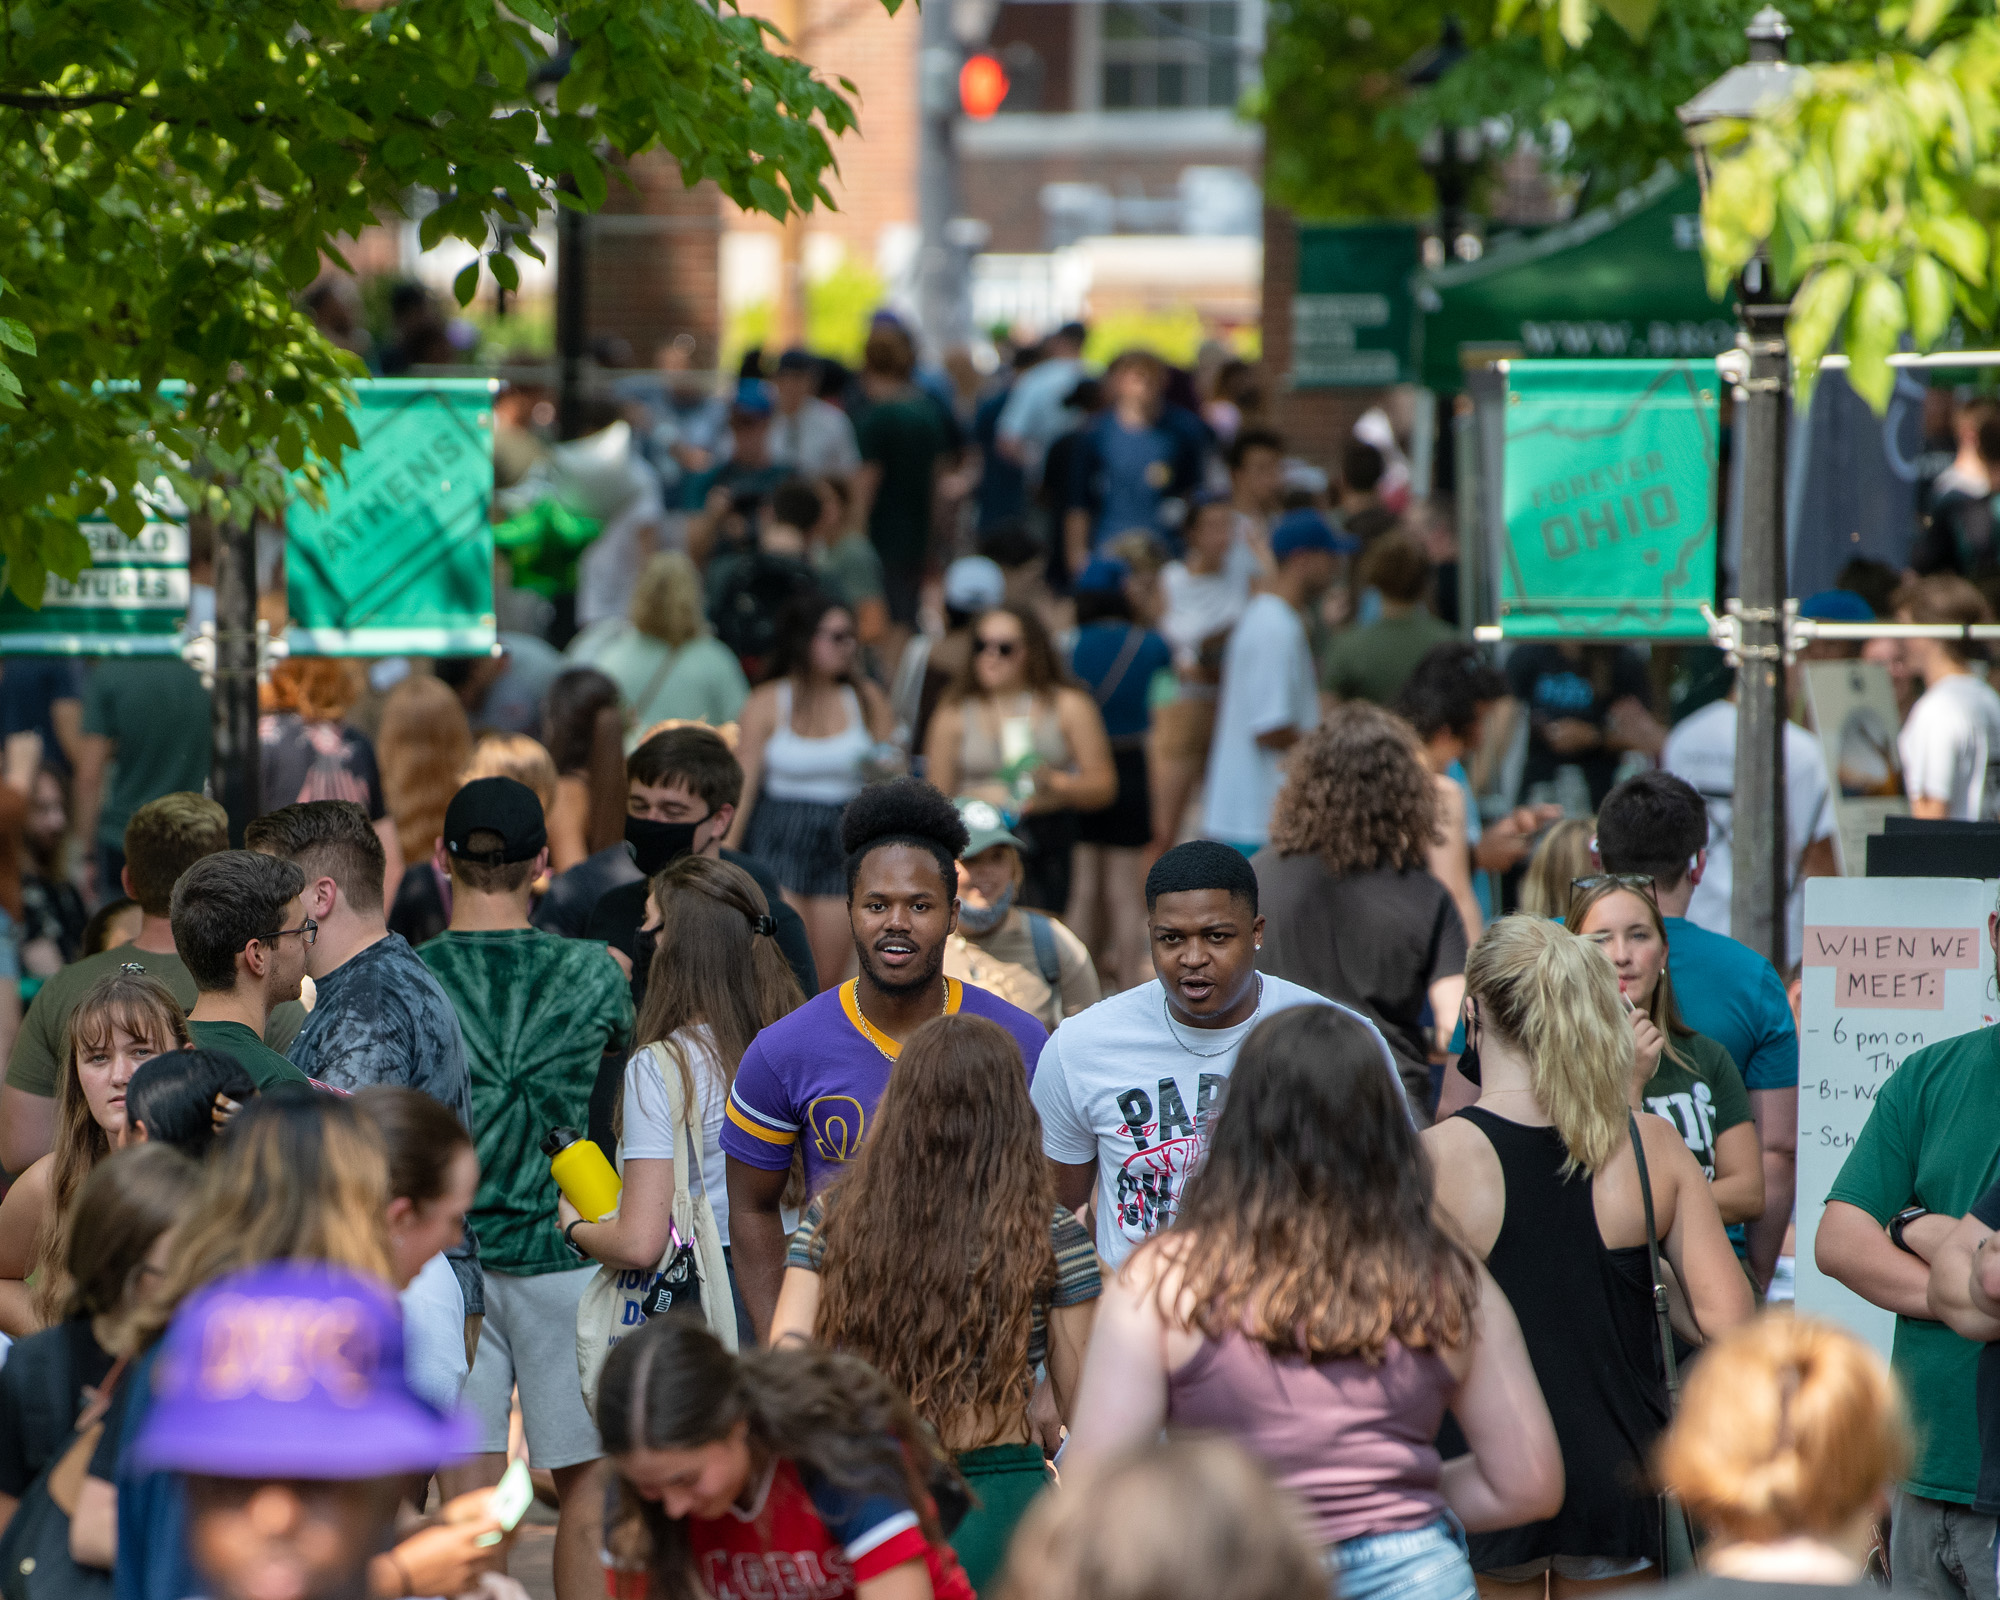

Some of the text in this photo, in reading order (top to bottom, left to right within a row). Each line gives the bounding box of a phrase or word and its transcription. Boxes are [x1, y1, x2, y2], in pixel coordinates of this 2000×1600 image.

[321, 430, 464, 562] ATHENS
[1531, 451, 1665, 509] FOREVER
[1541, 483, 1681, 562] OHIO
[56, 577, 169, 597] UTURES
[1816, 931, 1970, 959] WHEN WE
[1848, 972, 1936, 998] MEET:
